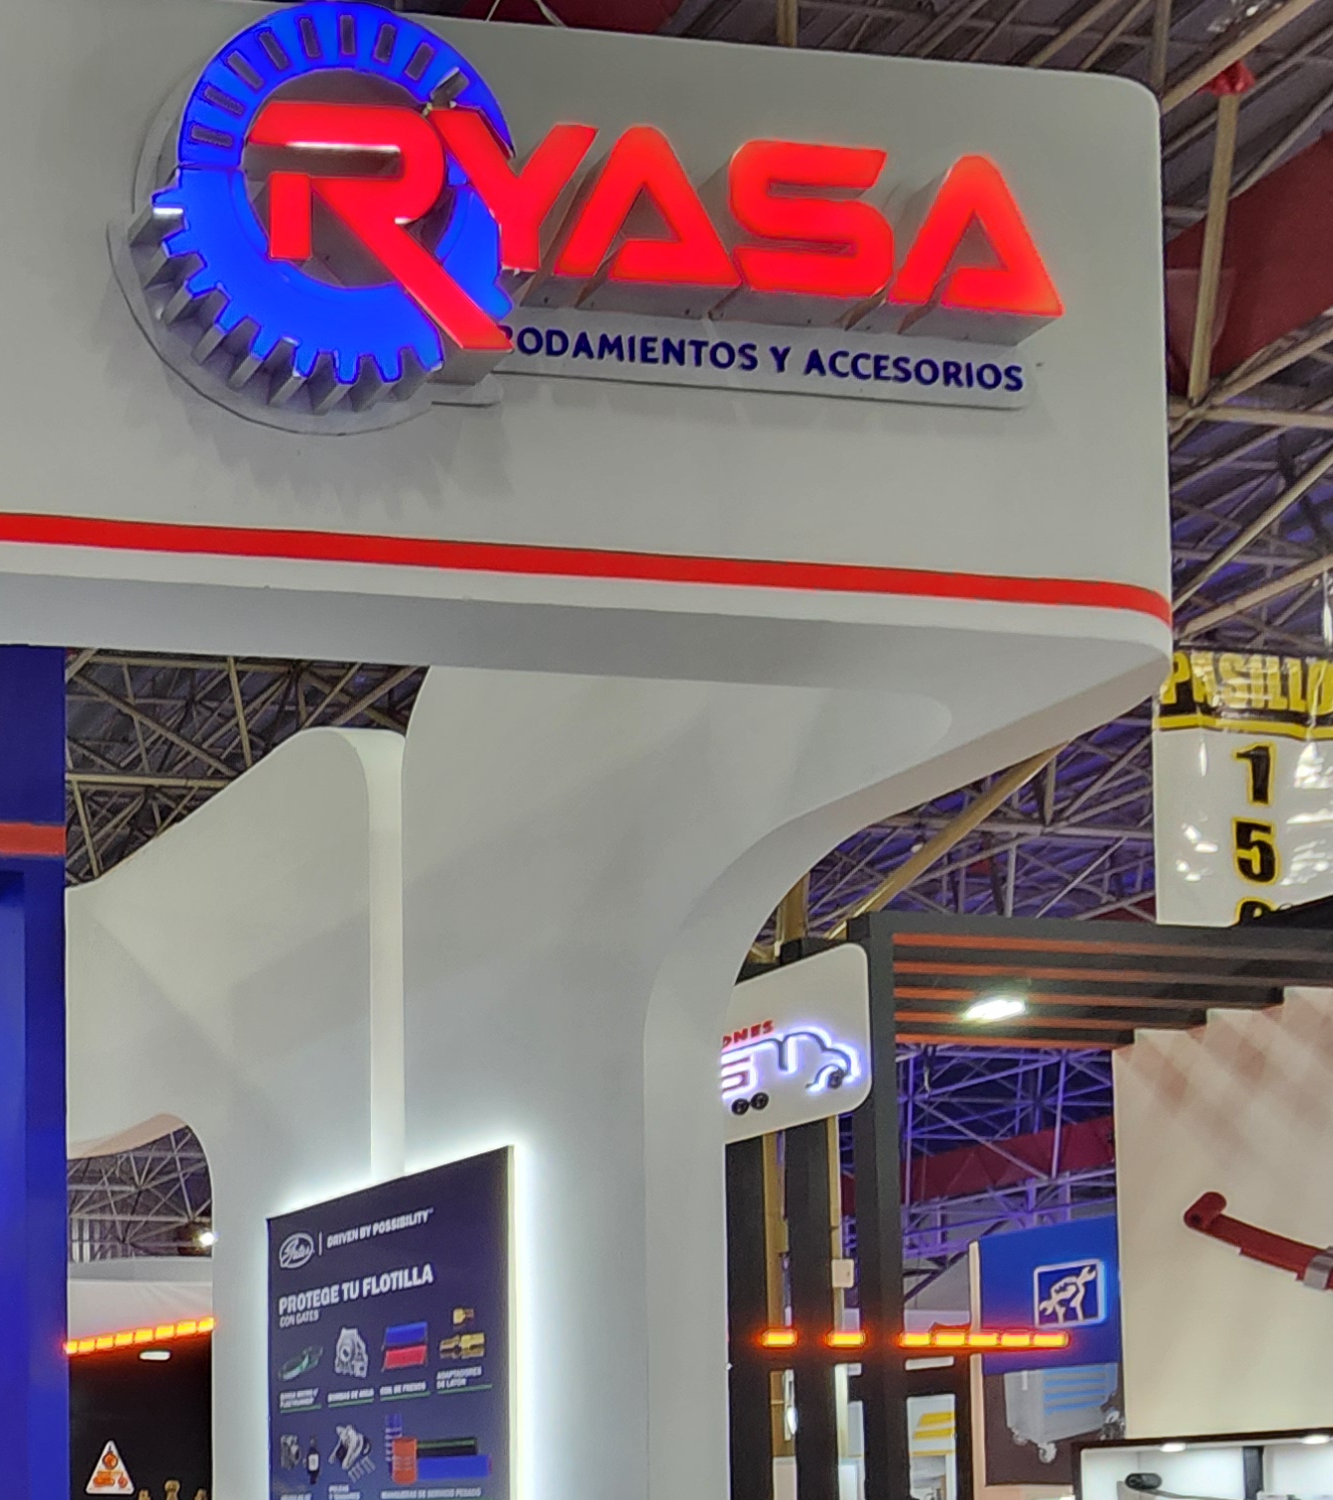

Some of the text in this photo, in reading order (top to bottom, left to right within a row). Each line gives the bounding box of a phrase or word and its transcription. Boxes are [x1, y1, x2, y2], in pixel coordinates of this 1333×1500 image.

[246, 101, 1063, 351] RYASA
[768, 344, 792, 374] Y
[803, 347, 1025, 393] ACCESORIOS
[327, 1228, 359, 1248] DRIVEN
[359, 1226, 372, 1240] BY
[279, 1263, 434, 1315] PROTEGE TU FLOTILLA
